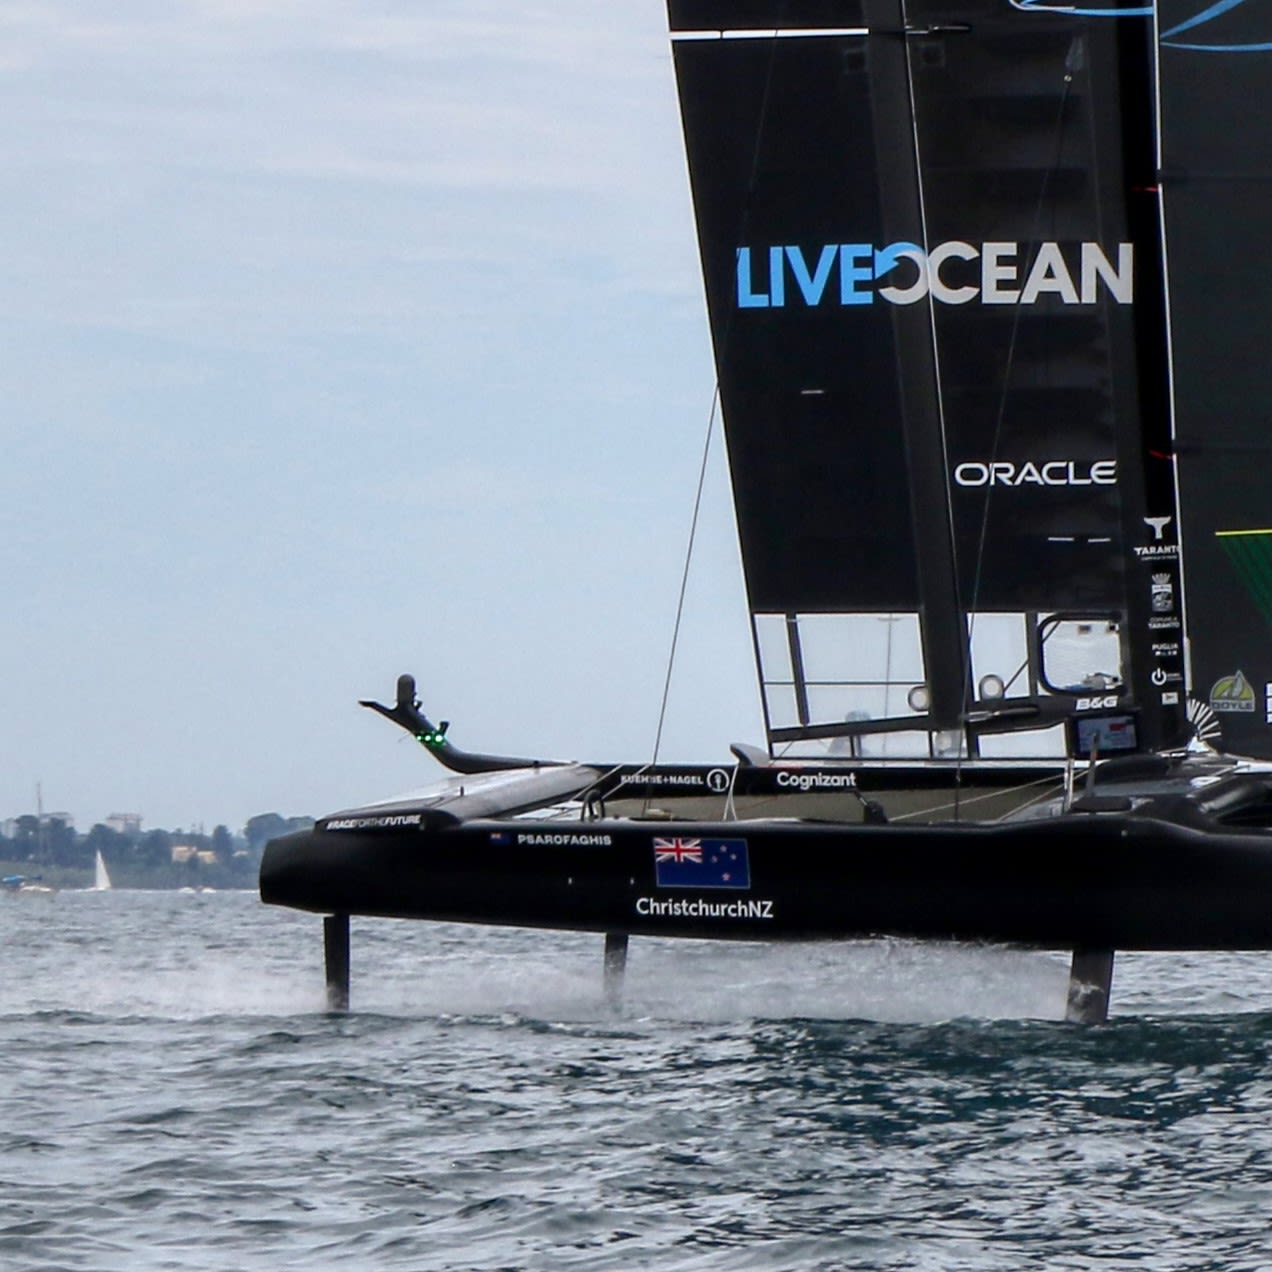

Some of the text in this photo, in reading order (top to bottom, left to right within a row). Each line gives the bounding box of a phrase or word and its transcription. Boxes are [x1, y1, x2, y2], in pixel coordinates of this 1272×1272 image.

[954, 460, 1117, 487] ORACLE
[1076, 696, 1118, 710] B&G
[777, 771, 857, 790] Cognizant
[517, 834, 612, 846] PSAROFAGHIS
[635, 897, 774, 919] ChristchurchNZ
